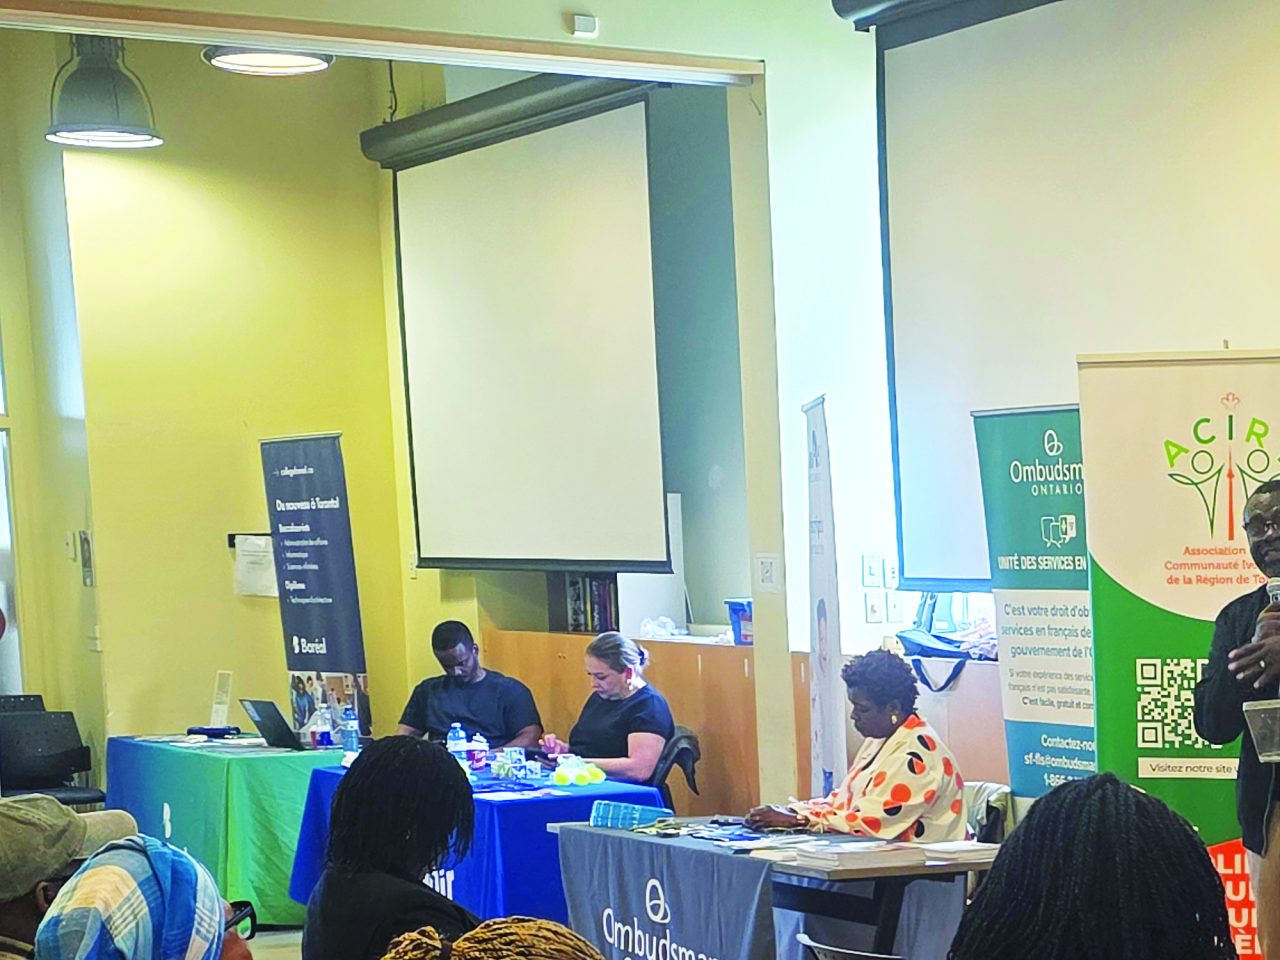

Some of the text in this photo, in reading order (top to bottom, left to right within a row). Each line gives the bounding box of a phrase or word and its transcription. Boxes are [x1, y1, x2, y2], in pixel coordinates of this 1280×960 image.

[1031, 483, 1082, 496] ONTARIO
[1183, 546, 1246, 557] Association
[1021, 556, 1037, 570] DES
[1038, 556, 1073, 570] SERVICES
[1164, 559, 1240, 572] Communauté
[1167, 574, 1181, 585] de
[1183, 575, 1193, 585] la
[1196, 574, 1233, 587] Région
[1235, 574, 1250, 585] de
[1004, 603, 1025, 617] C'est
[1027, 605, 1049, 617] votre
[1050, 604, 1070, 617] droit
[1036, 627, 1046, 637] en
[1072, 646, 1083, 658] de
[1150, 763, 1183, 773] Visitez
[1185, 764, 1213, 773] notre
[1215, 763, 1232, 773] site
